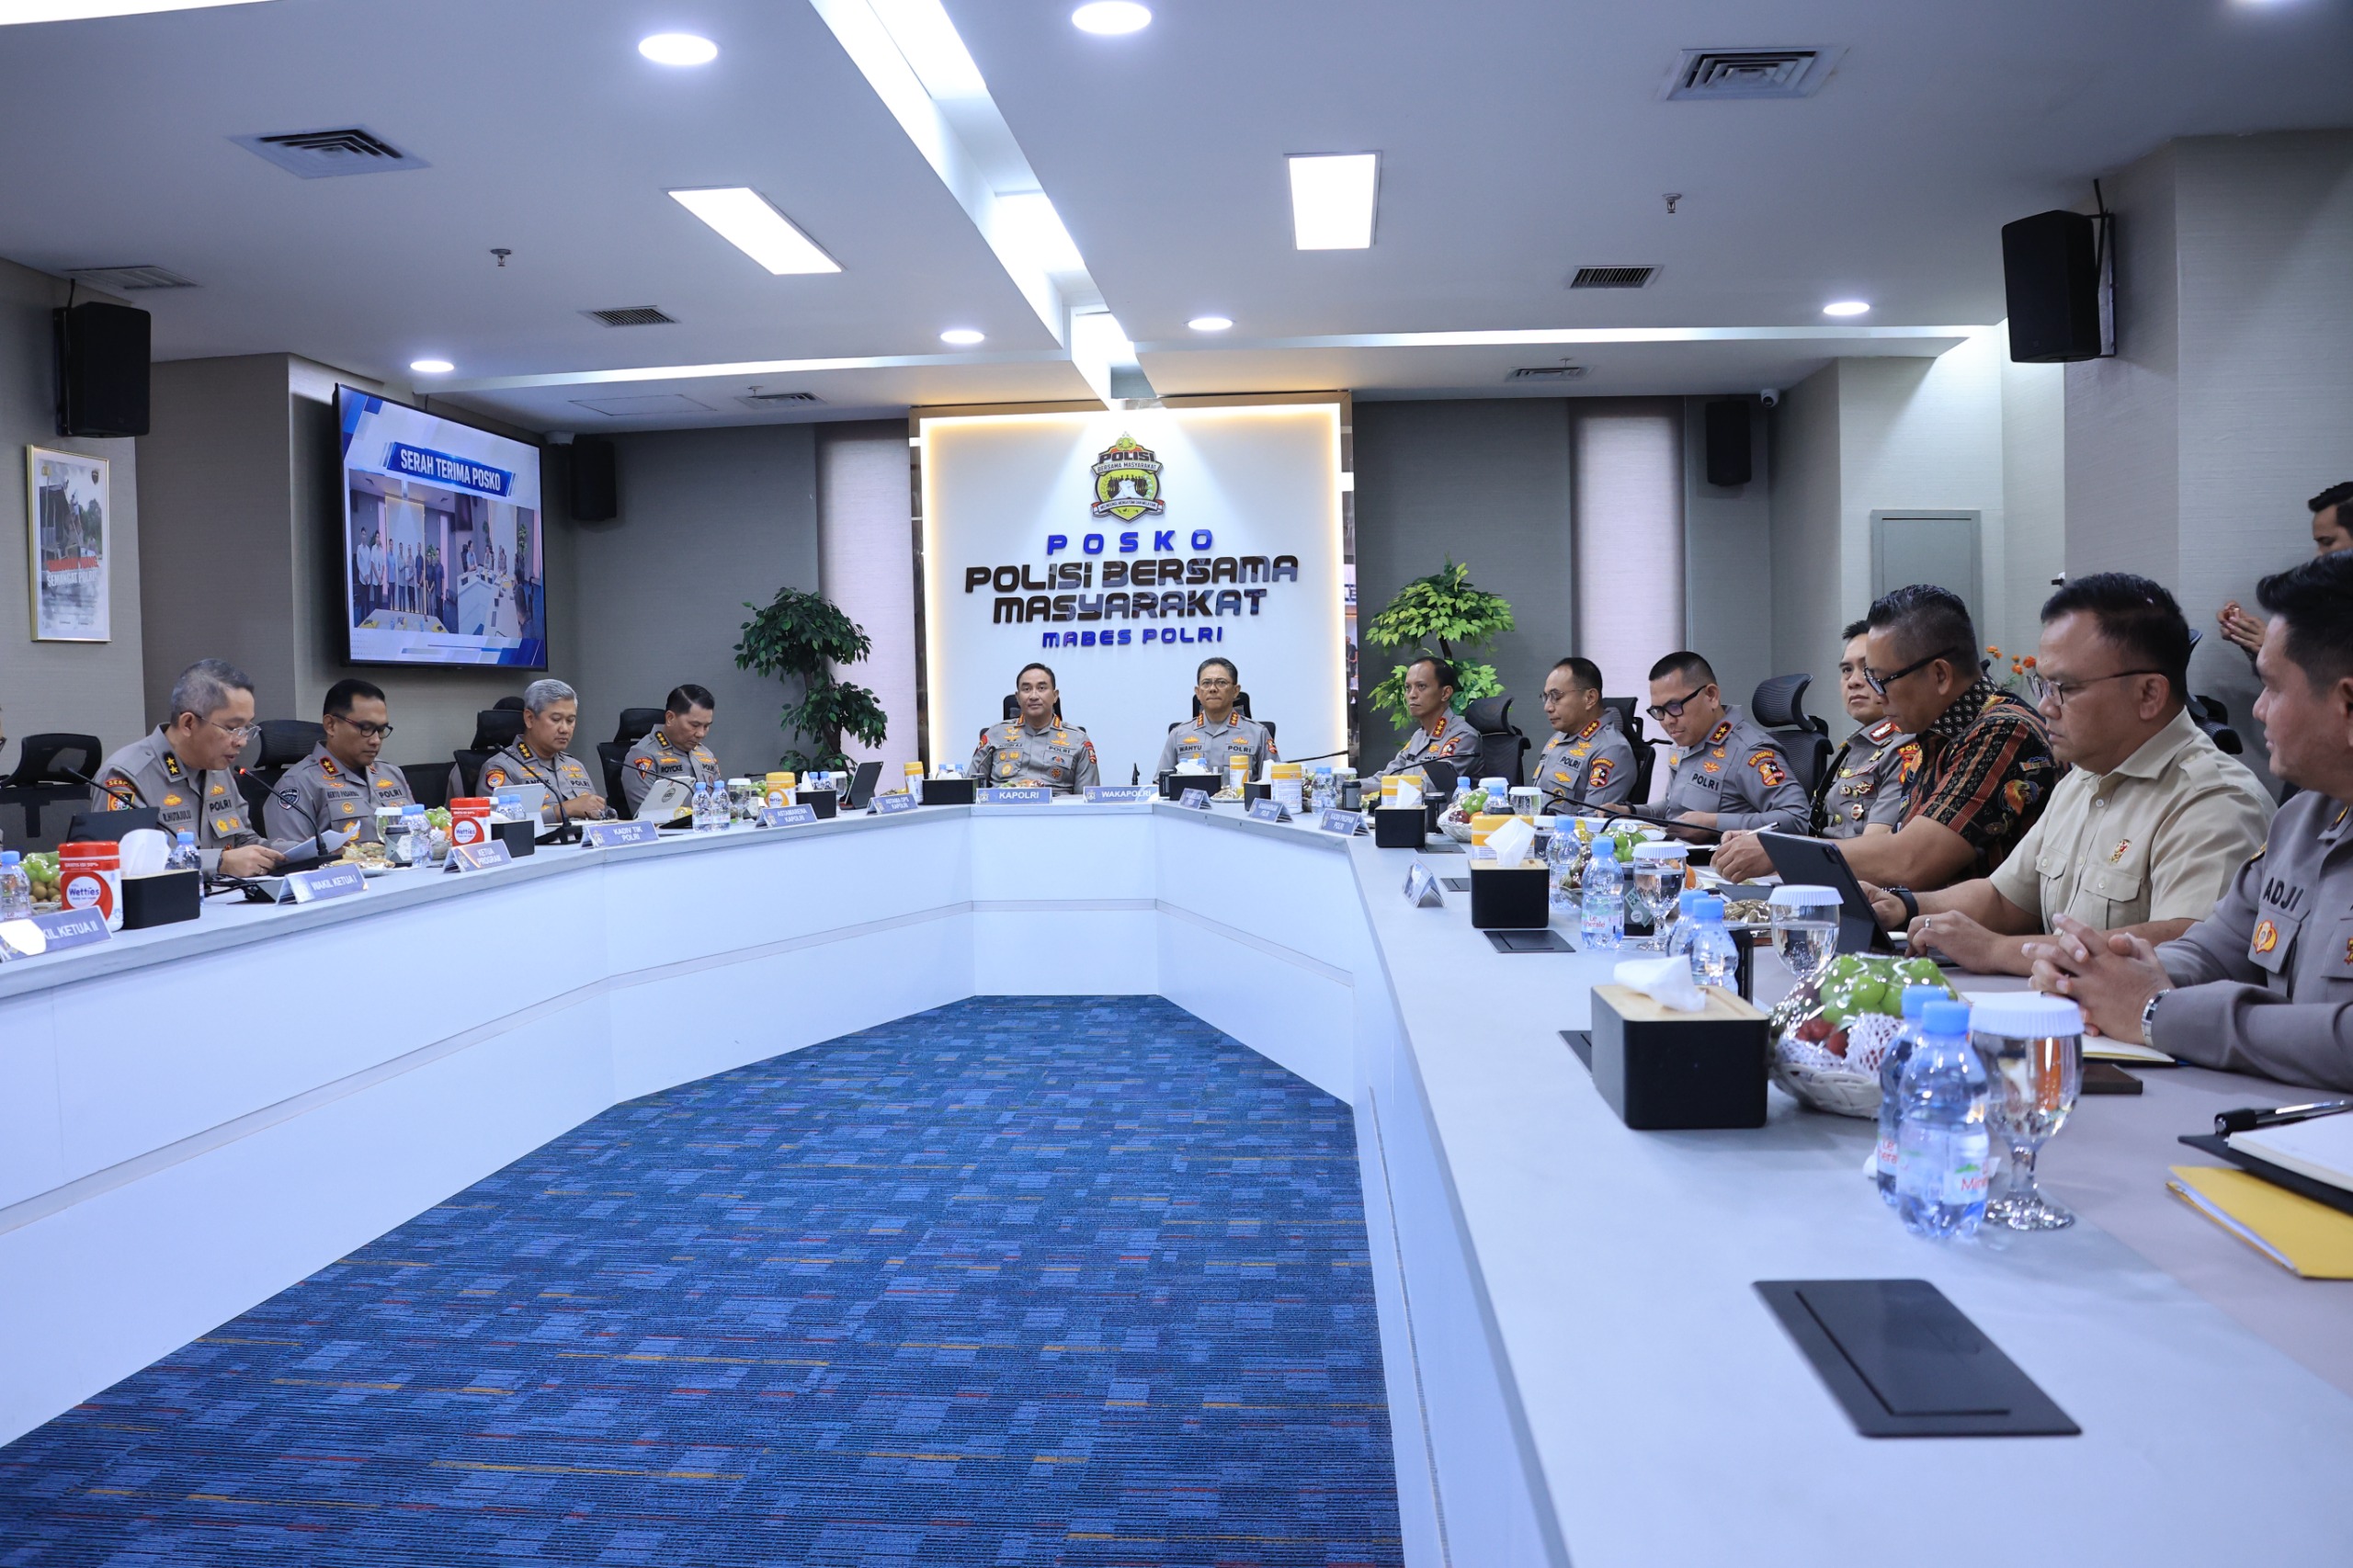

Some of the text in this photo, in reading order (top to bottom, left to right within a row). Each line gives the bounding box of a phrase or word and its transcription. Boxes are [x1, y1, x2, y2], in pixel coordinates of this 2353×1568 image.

[1099, 450, 1155, 464] POLISI
[400, 449, 501, 492] SERAH TERIMA POSKO
[1097, 461, 1157, 472] BERSAMA MASYARAKAT
[1047, 529, 1212, 555] POSKO
[965, 555, 1299, 593] POLISI BERSAMA
[994, 589, 1267, 623] MASYARAKAT
[1042, 627, 1222, 648] MABES POLRI
[1049, 745, 1071, 754] POLRI
[1227, 745, 1252, 754] POLRI
[1559, 756, 1581, 769] POLRI
[661, 765, 683, 773] ROYCKE
[1691, 774, 1720, 790] POLRI
[379, 789, 403, 798] POLRI
[999, 791, 1040, 800] KAPOLRI
[210, 800, 232, 812] POLRI
[777, 808, 808, 817] ASTAMARENA
[612, 827, 632, 835] KADIV
[477, 847, 494, 857] KETUA
[477, 855, 502, 865] PROGRAM
[311, 874, 358, 891] WAKIL KETUA I
[69, 886, 99, 896] Wetties
[2263, 877, 2304, 912] ADJI
[43, 921, 99, 940] KIL KETUA II
